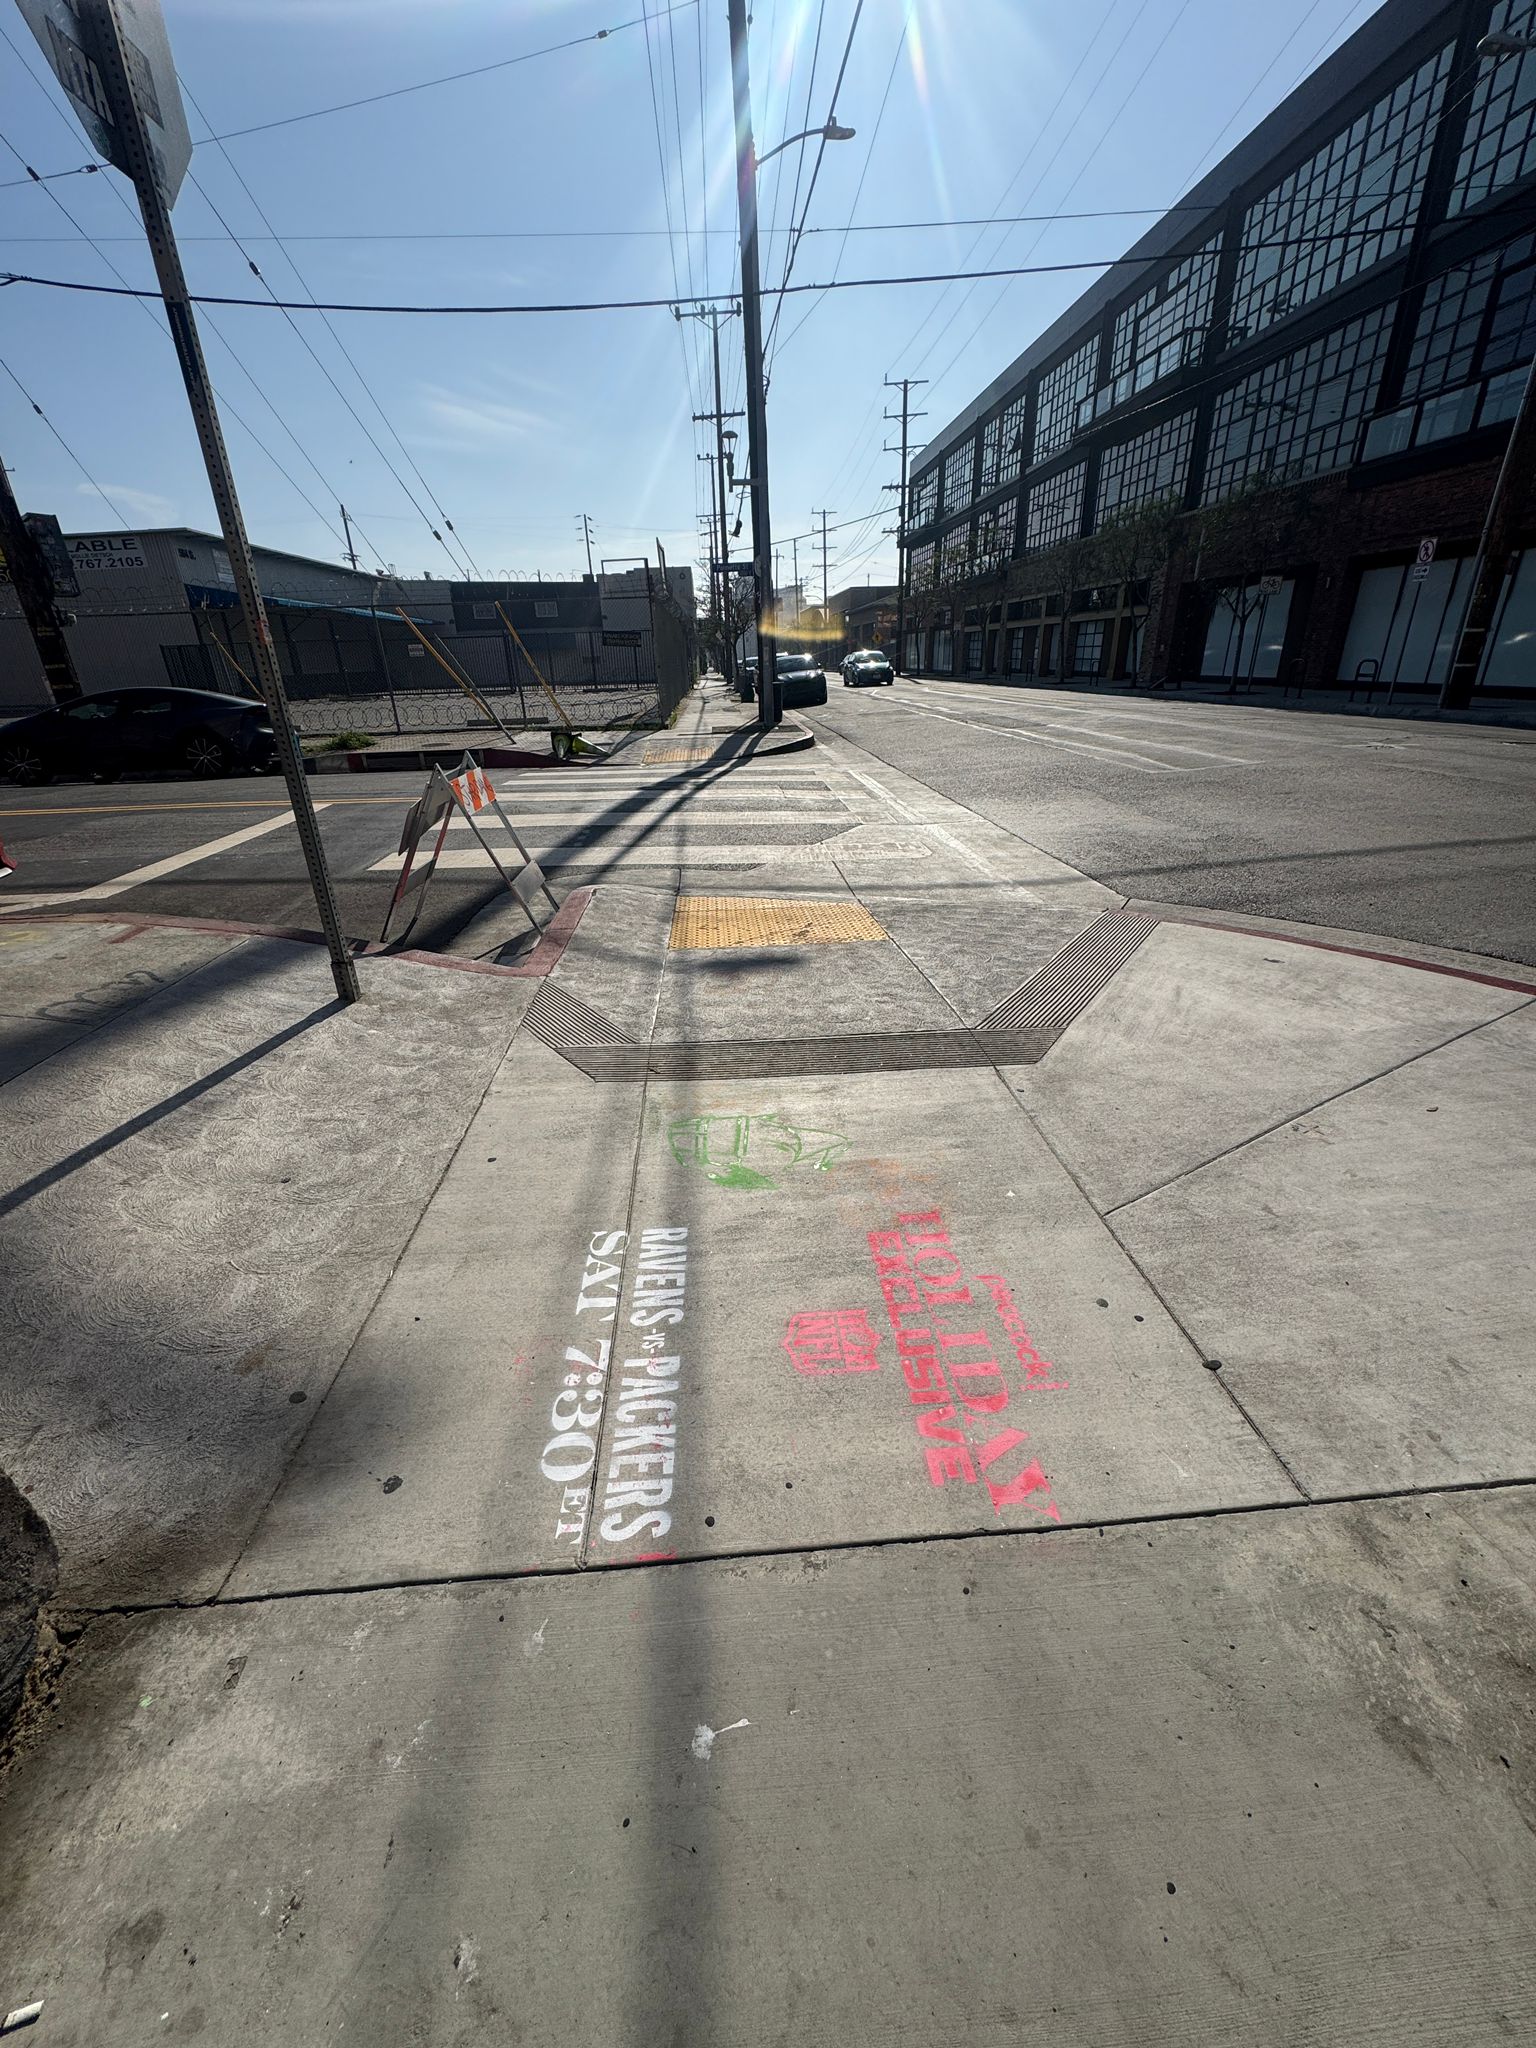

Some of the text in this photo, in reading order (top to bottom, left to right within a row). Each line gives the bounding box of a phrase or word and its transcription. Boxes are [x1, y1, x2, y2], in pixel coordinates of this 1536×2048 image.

[629, 1227, 689, 1327] RAVENS
[792, 1316, 843, 1371] NFL
[867, 1231, 978, 1488] EXCLUSIVE
[897, 1208, 1062, 1524] HOLIDAY
[971, 1274, 1053, 1381] peacock
[541, 1230, 630, 1544] SAT 7:30 ET
[600, 1355, 681, 1542] PACKERS
